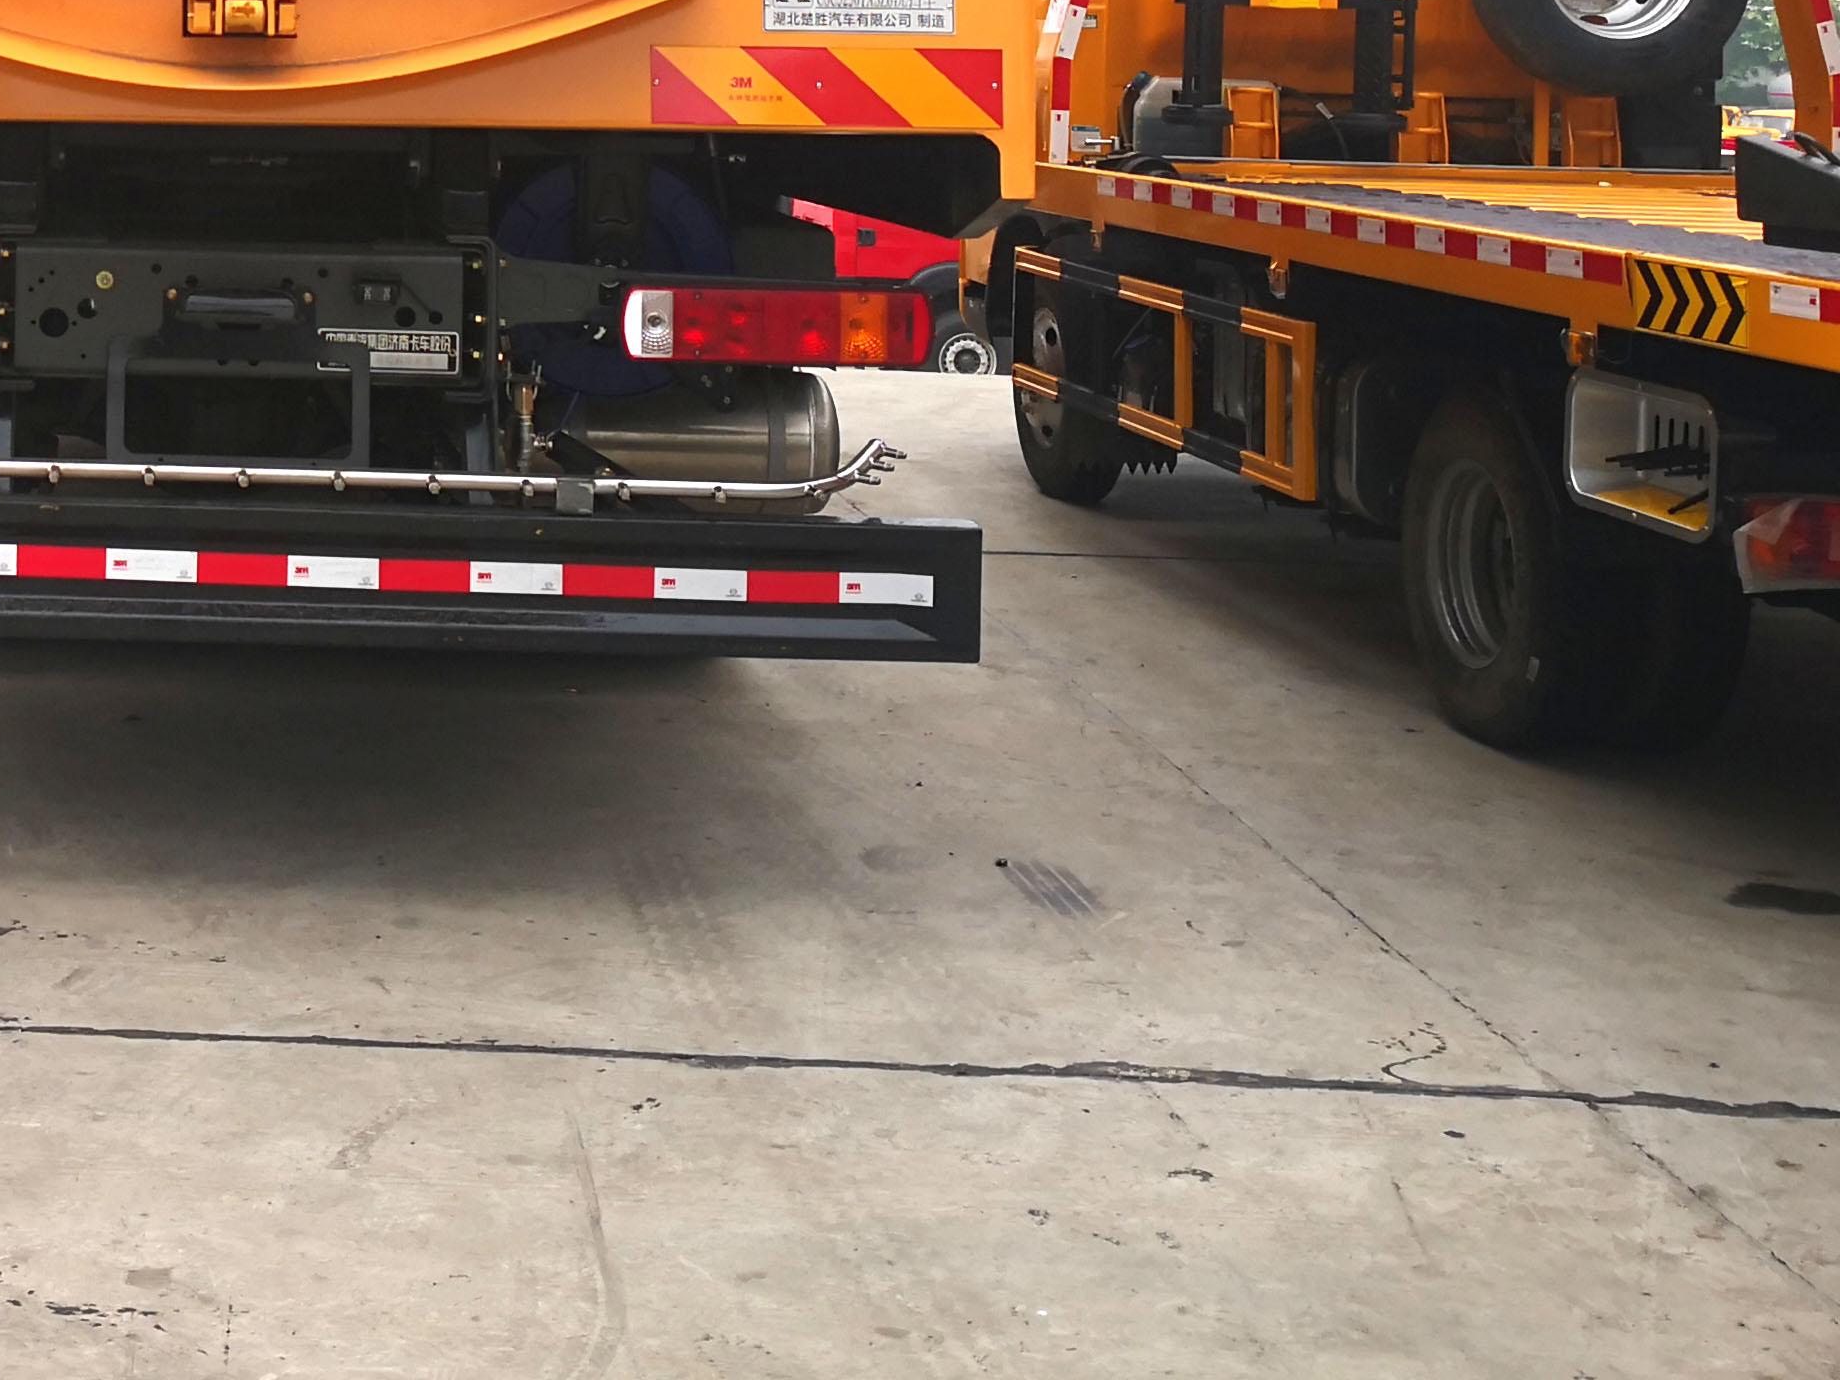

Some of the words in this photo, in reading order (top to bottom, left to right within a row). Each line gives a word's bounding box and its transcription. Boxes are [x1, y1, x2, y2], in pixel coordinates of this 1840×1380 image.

[772, 11, 912, 28] 湖北楚胜汽车有限公司
[730, 76, 752, 88] 3M
